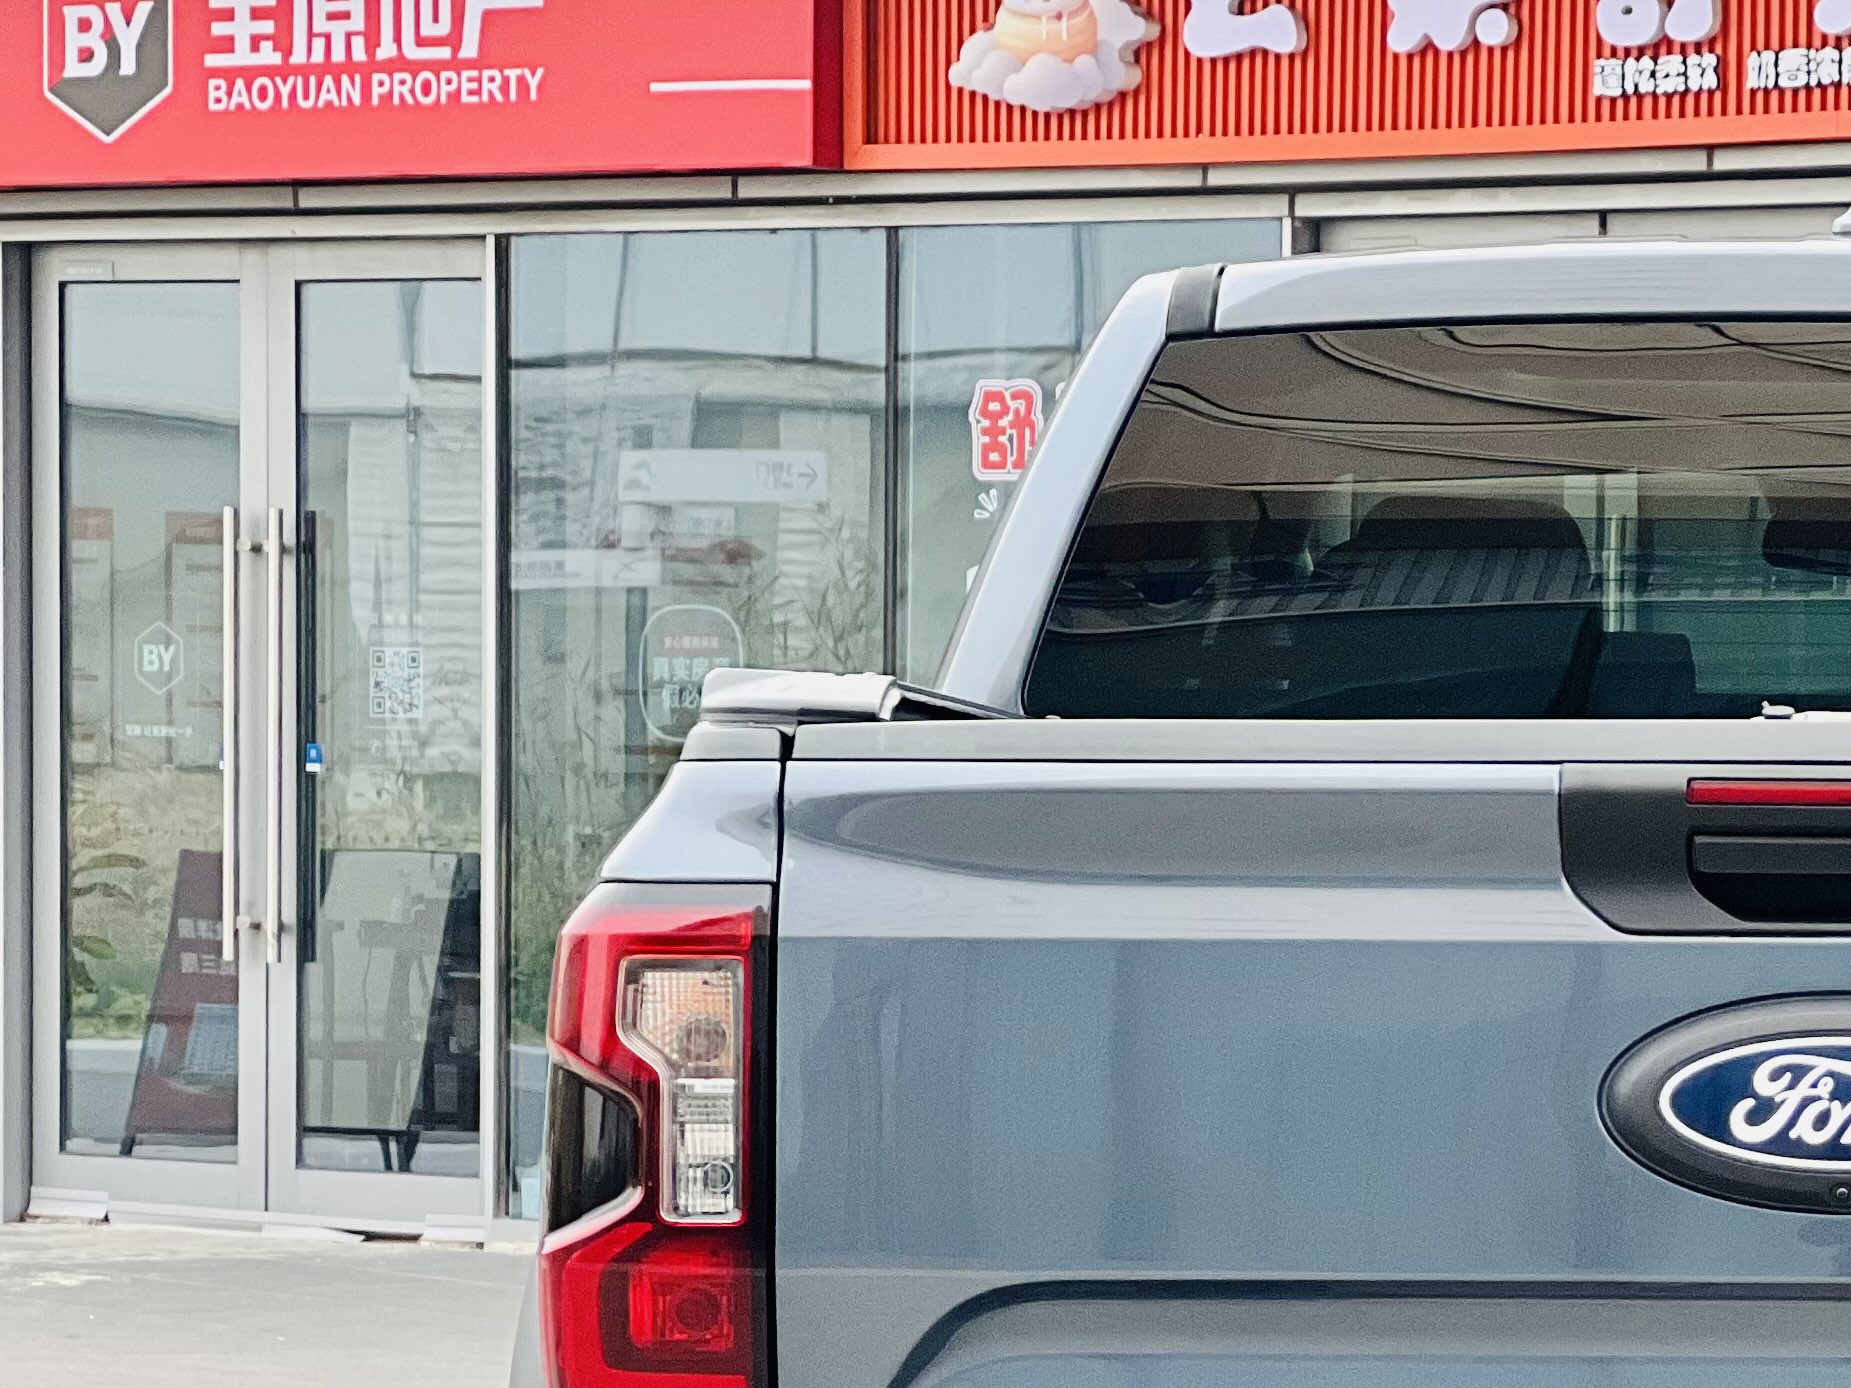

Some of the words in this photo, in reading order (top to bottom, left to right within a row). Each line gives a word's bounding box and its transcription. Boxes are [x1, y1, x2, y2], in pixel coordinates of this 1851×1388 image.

[62, 1, 153, 78] BY
[208, 74, 361, 111] BAOYUAN
[371, 67, 544, 106] PROPERTY
[977, 387, 1038, 472] 舒
[142, 644, 175, 672] BY
